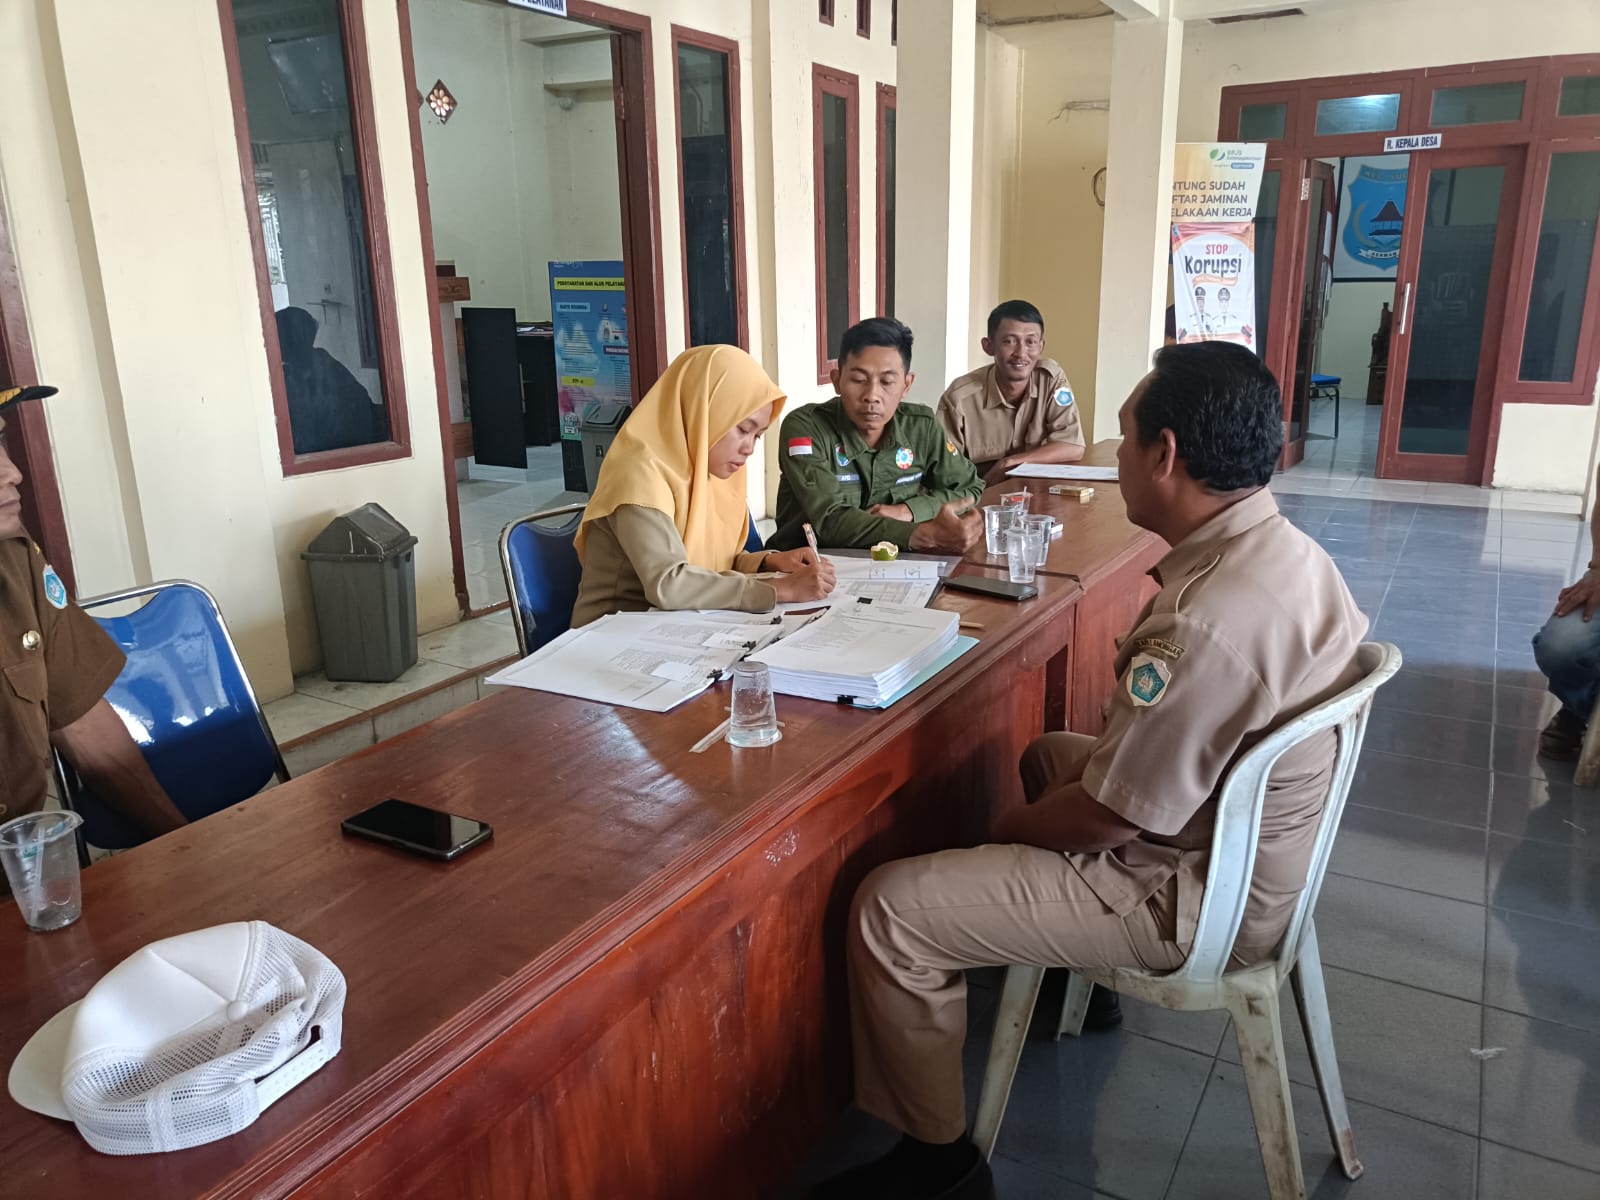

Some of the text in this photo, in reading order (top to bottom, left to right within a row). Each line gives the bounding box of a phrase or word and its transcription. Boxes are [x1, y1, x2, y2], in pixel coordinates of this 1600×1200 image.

[1396, 137, 1419, 148] KEPALA
[1421, 135, 1438, 146] DESA
[1209, 181, 1246, 191] SUDAH
[1200, 194, 1248, 204] JAMINAN
[1222, 208, 1252, 217] KERJA
[1205, 244, 1228, 255] STOP
[1184, 253, 1242, 277] Korupsi
